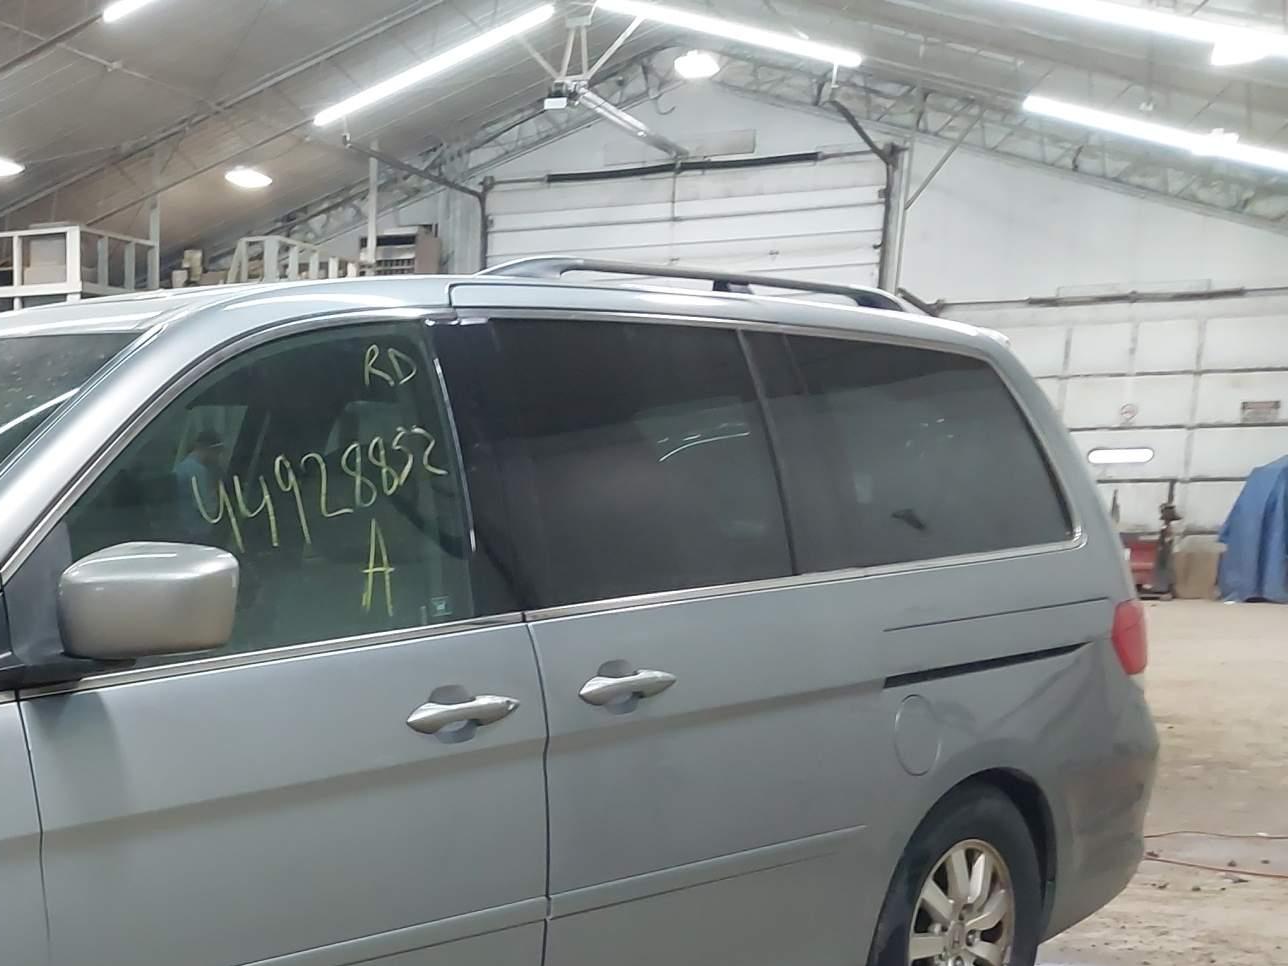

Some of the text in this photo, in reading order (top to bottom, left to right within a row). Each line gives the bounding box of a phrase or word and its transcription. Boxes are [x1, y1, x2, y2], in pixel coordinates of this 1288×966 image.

[364, 344, 416, 387] RD
[191, 425, 449, 553] 44928852
[361, 518, 395, 616] A
